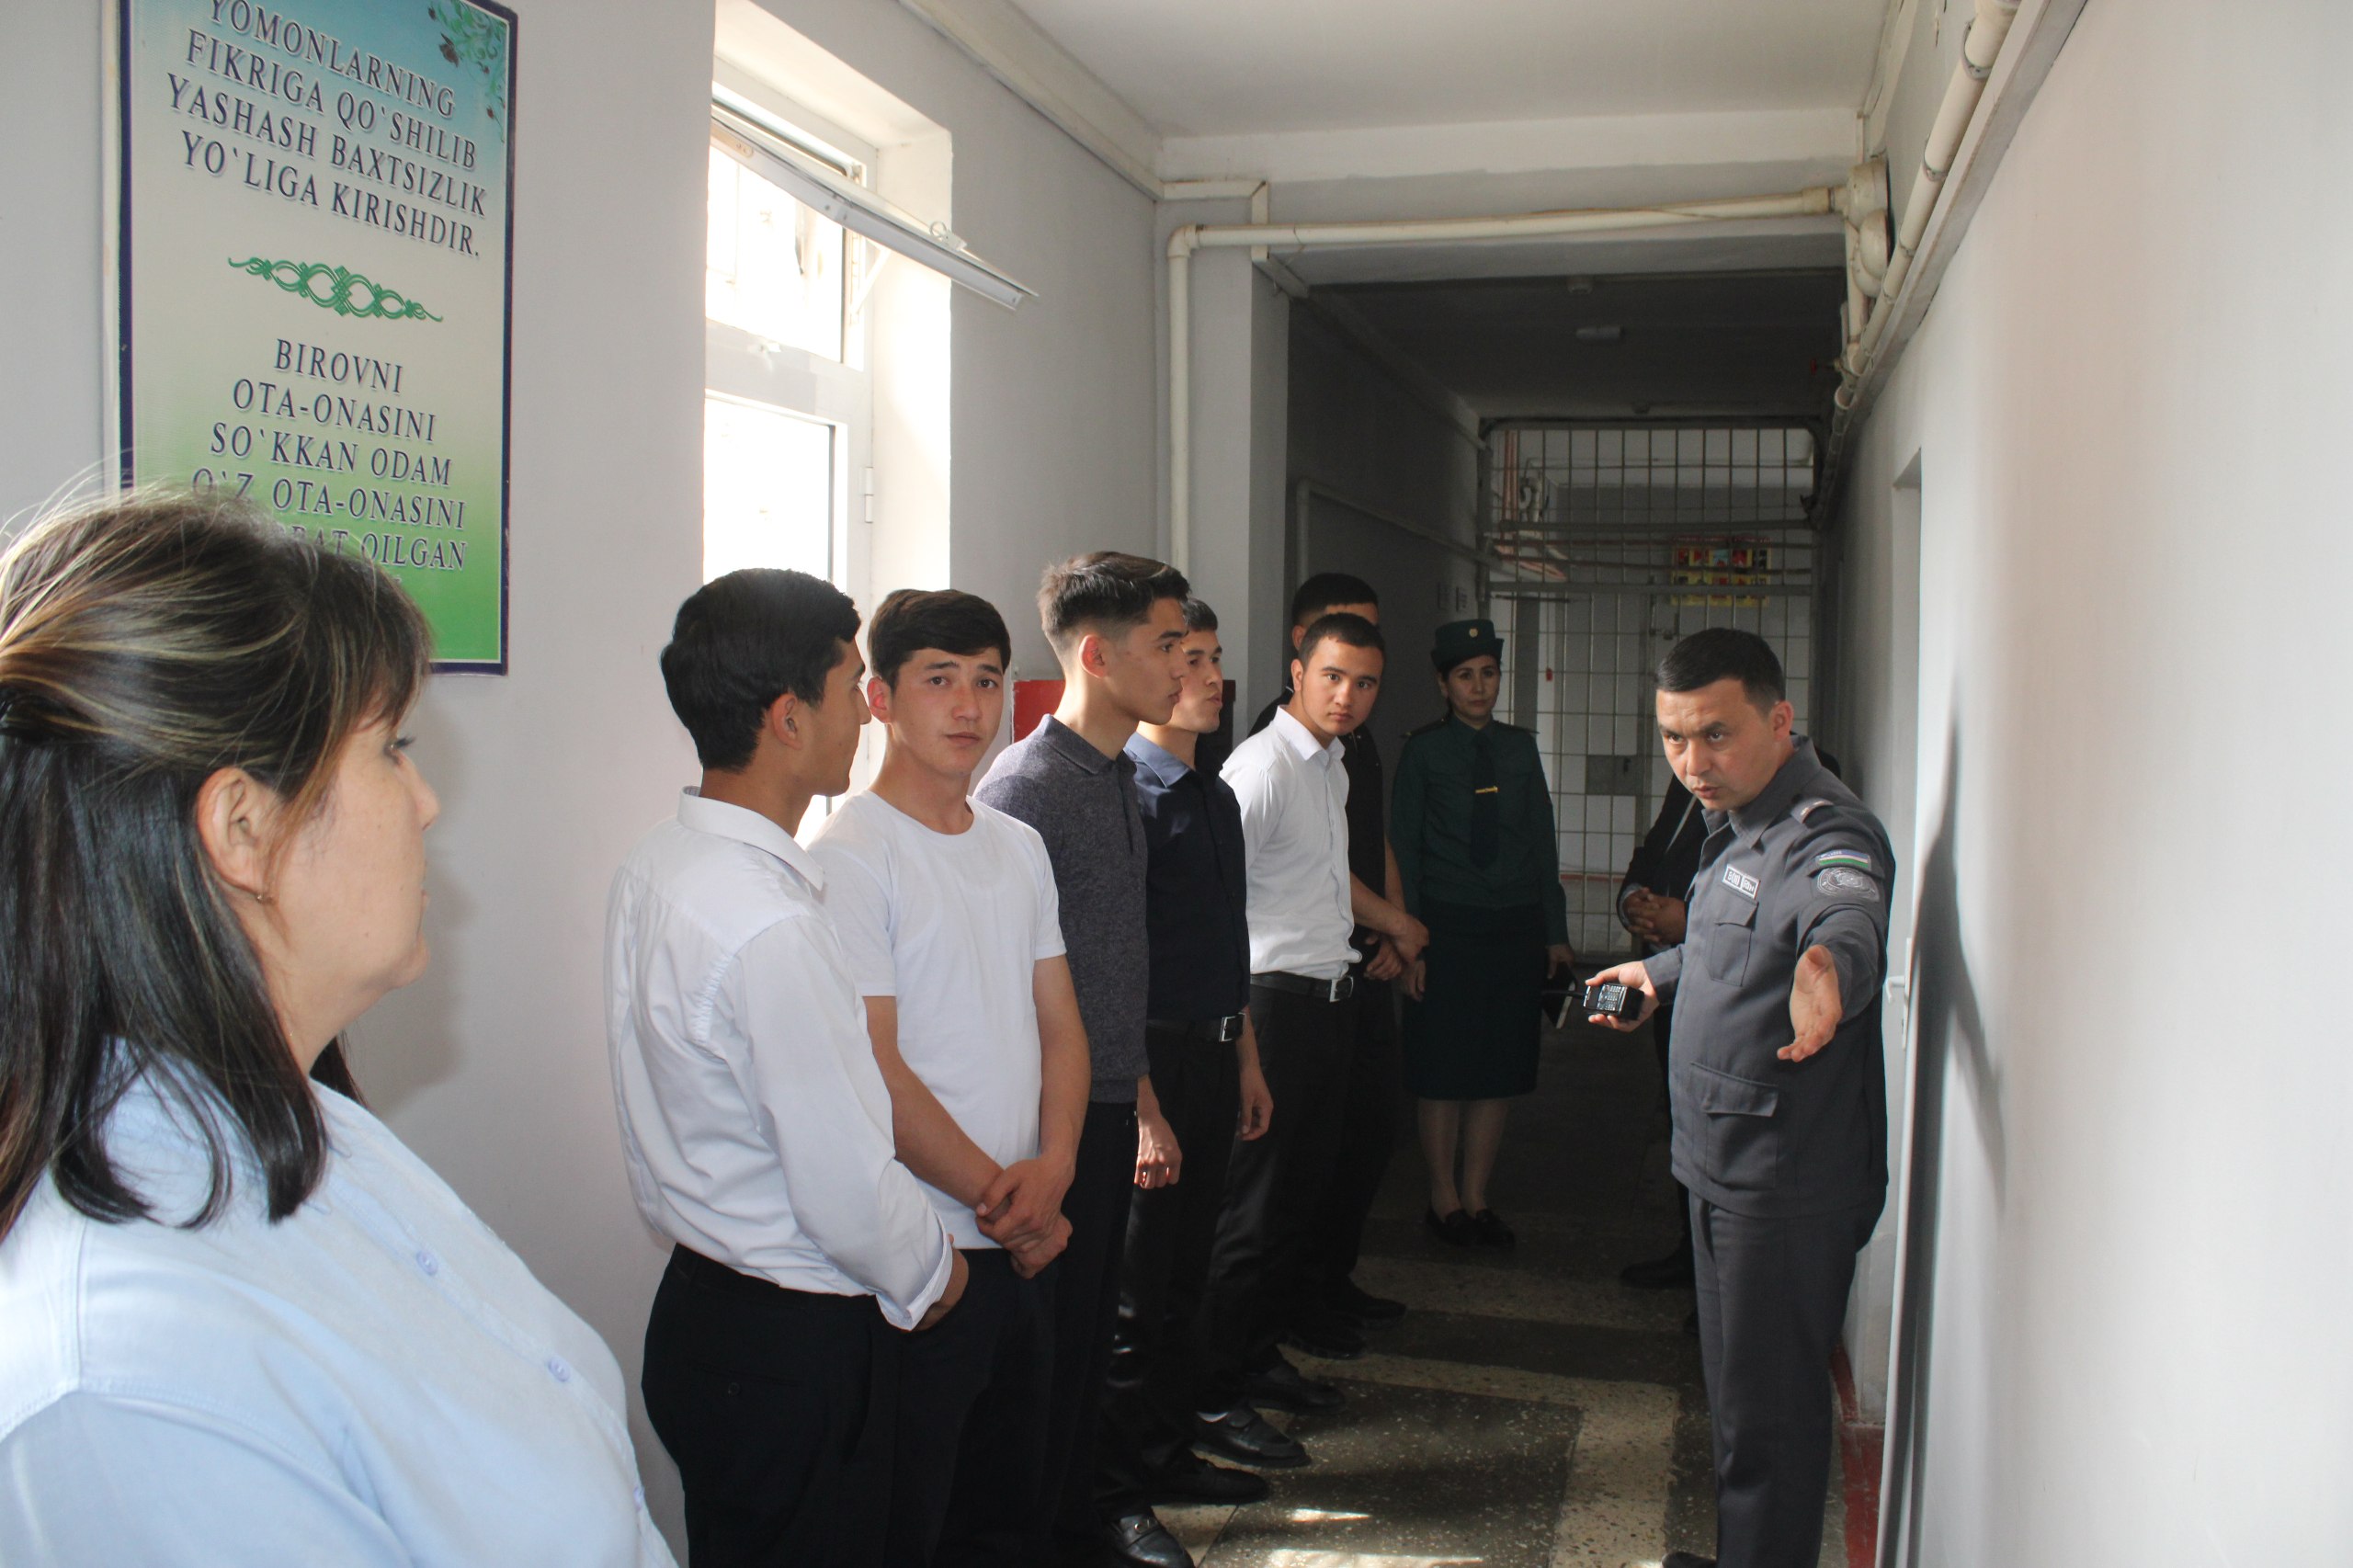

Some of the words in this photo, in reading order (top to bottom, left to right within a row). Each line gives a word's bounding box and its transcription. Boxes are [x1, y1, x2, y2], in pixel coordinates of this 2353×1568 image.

[186, 28, 324, 112] FIKRIGA
[210, 0, 455, 118] YOMONLARNING
[166, 73, 317, 157] YASHASH
[331, 134, 485, 216] BAXTSIZLIK
[331, 182, 479, 256] KIRISHDIR.
[274, 339, 403, 392] BIROVNI
[233, 379, 436, 442] OTA-ONASINI
[370, 448, 451, 485] ODAM
[272, 478, 466, 529] OTA-ONASINI
